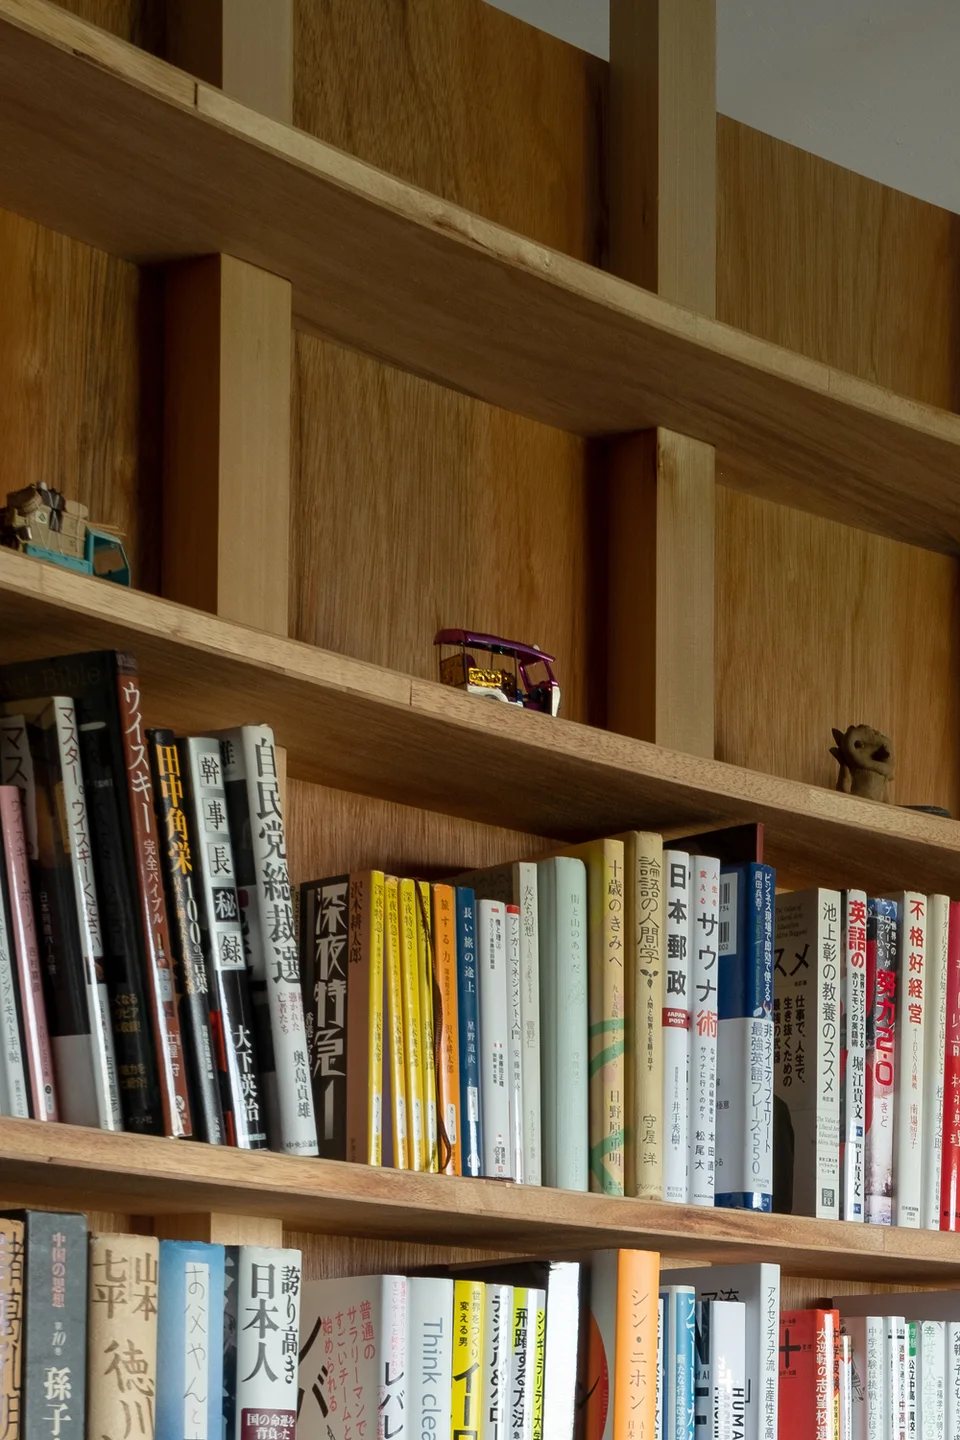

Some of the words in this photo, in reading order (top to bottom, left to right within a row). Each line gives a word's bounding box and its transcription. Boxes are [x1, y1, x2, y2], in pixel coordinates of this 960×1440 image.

[122, 682, 151, 835] ウイスキー
[155, 743, 193, 875] 田中角栄
[254, 737, 300, 985] 自民党総裁選
[699, 871, 707, 904] 変える
[201, 753, 240, 965] 幹事長秘録
[233, 1024, 259, 1123] 大下英治
[440, 898, 451, 964] 旅する力
[523, 884, 534, 937] 友だち幻想
[607, 859, 623, 968] 十歳のきみへ
[636, 856, 661, 964] 論語の人間学
[666, 864, 687, 996] 日本郵政
[764, 873, 773, 1001] ビジネス現場で即効で使える
[848, 900, 866, 969] 英語の
[462, 907, 476, 994] 長い旅の途上
[695, 912, 719, 1038] サウナ術
[908, 900, 924, 1025] 不格好経営
[668, 1017, 685, 1025] POST
[821, 902, 837, 1094] 池上彰の教養のススメ
[875, 969, 897, 1087] 努力2.0
[467, 1020, 476, 1064] 星野道夫
[671, 1101, 681, 1144] 井手秀樹
[851, 1055, 864, 1120] 堀江貴文
[879, 1087, 889, 1128] ときど
[608, 1088, 621, 1168] 日野原重明
[707, 1131, 715, 1186] 本田直之
[52, 1231, 66, 1308] 中国の思想
[93, 1248, 128, 1320] 七平
[132, 1252, 158, 1323] 山本
[241, 1263, 280, 1384] 日本人
[280, 1262, 300, 1385] 誇り高き
[359, 1299, 376, 1362] 普通の
[422, 1317, 444, 1385] Think
[458, 1300, 469, 1348] 変える男
[629, 1288, 650, 1412] シン・ニホン
[765, 1286, 776, 1372] アクセンチュア流
[322, 1315, 337, 1413] 始められる
[246, 1412, 295, 1427] 国の命運を
[256, 1427, 291, 1440] 背負った
